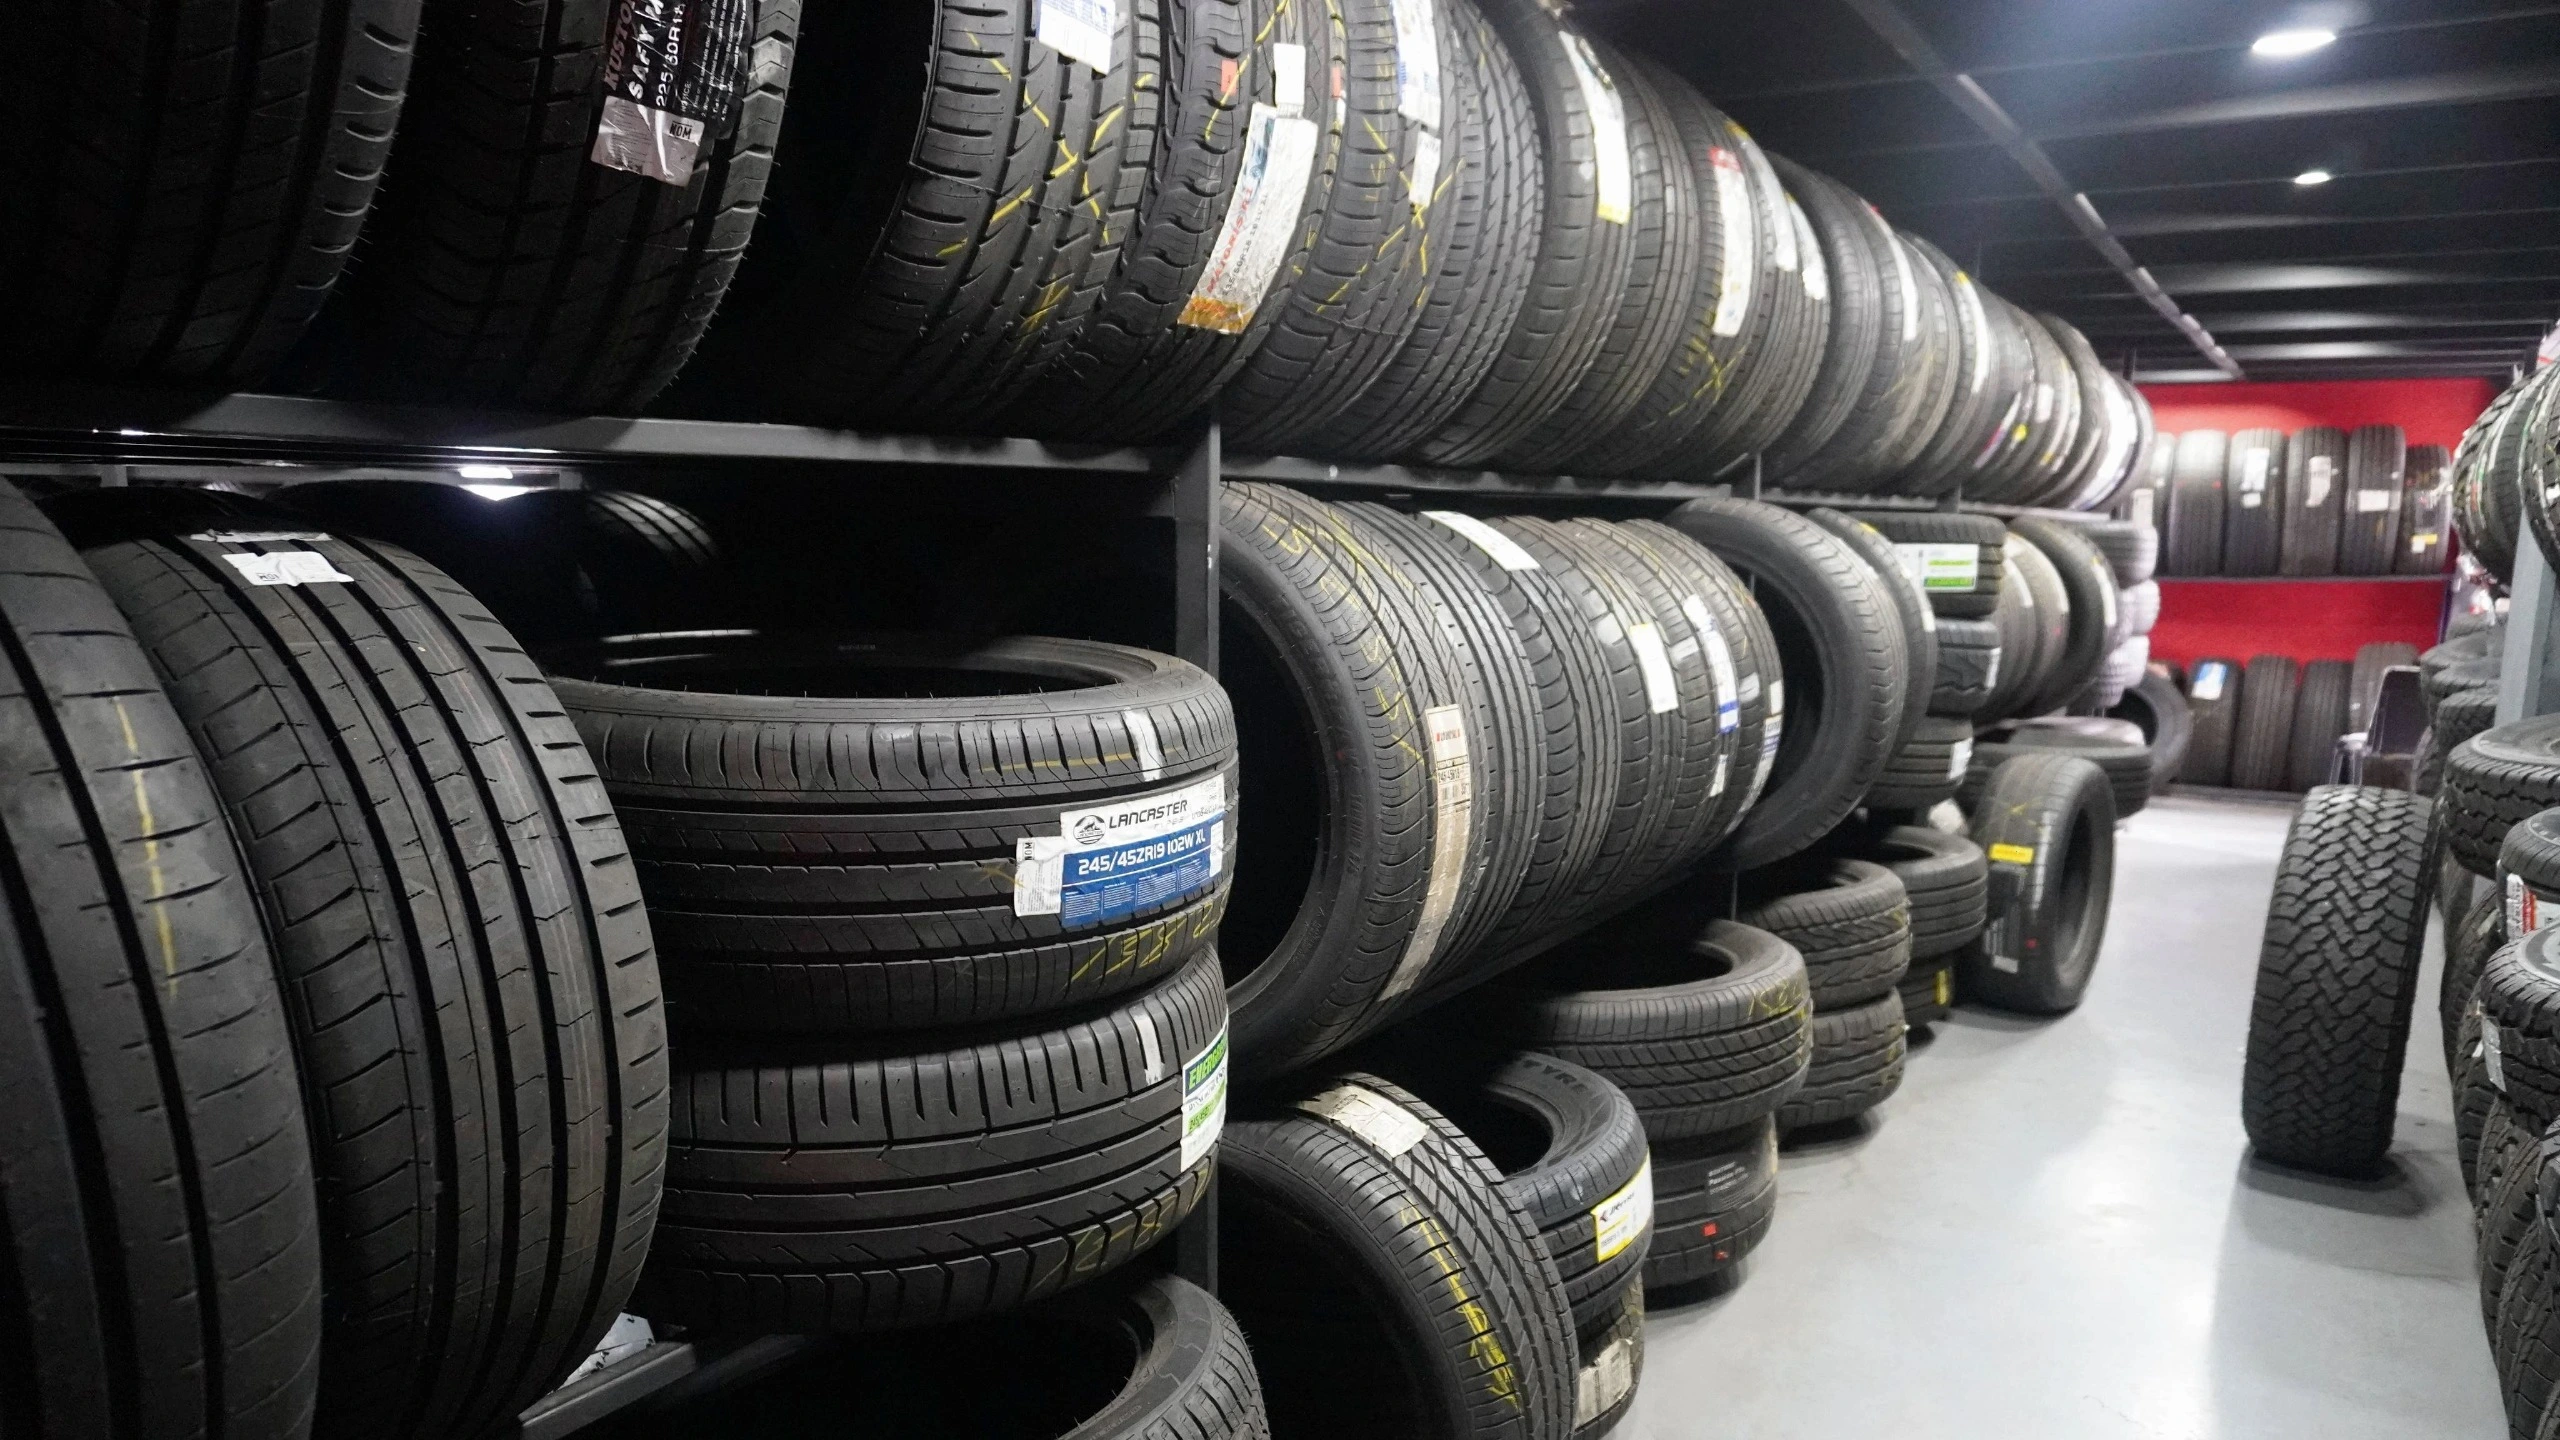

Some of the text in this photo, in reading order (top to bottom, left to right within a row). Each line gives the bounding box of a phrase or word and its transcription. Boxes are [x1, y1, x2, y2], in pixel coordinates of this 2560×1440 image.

[628, 23, 655, 100] SAFY
[1109, 799, 1188, 829] LANCASTER
[1078, 844, 1166, 876] 245/45ZR19
[1195, 829, 1206, 844] XL
